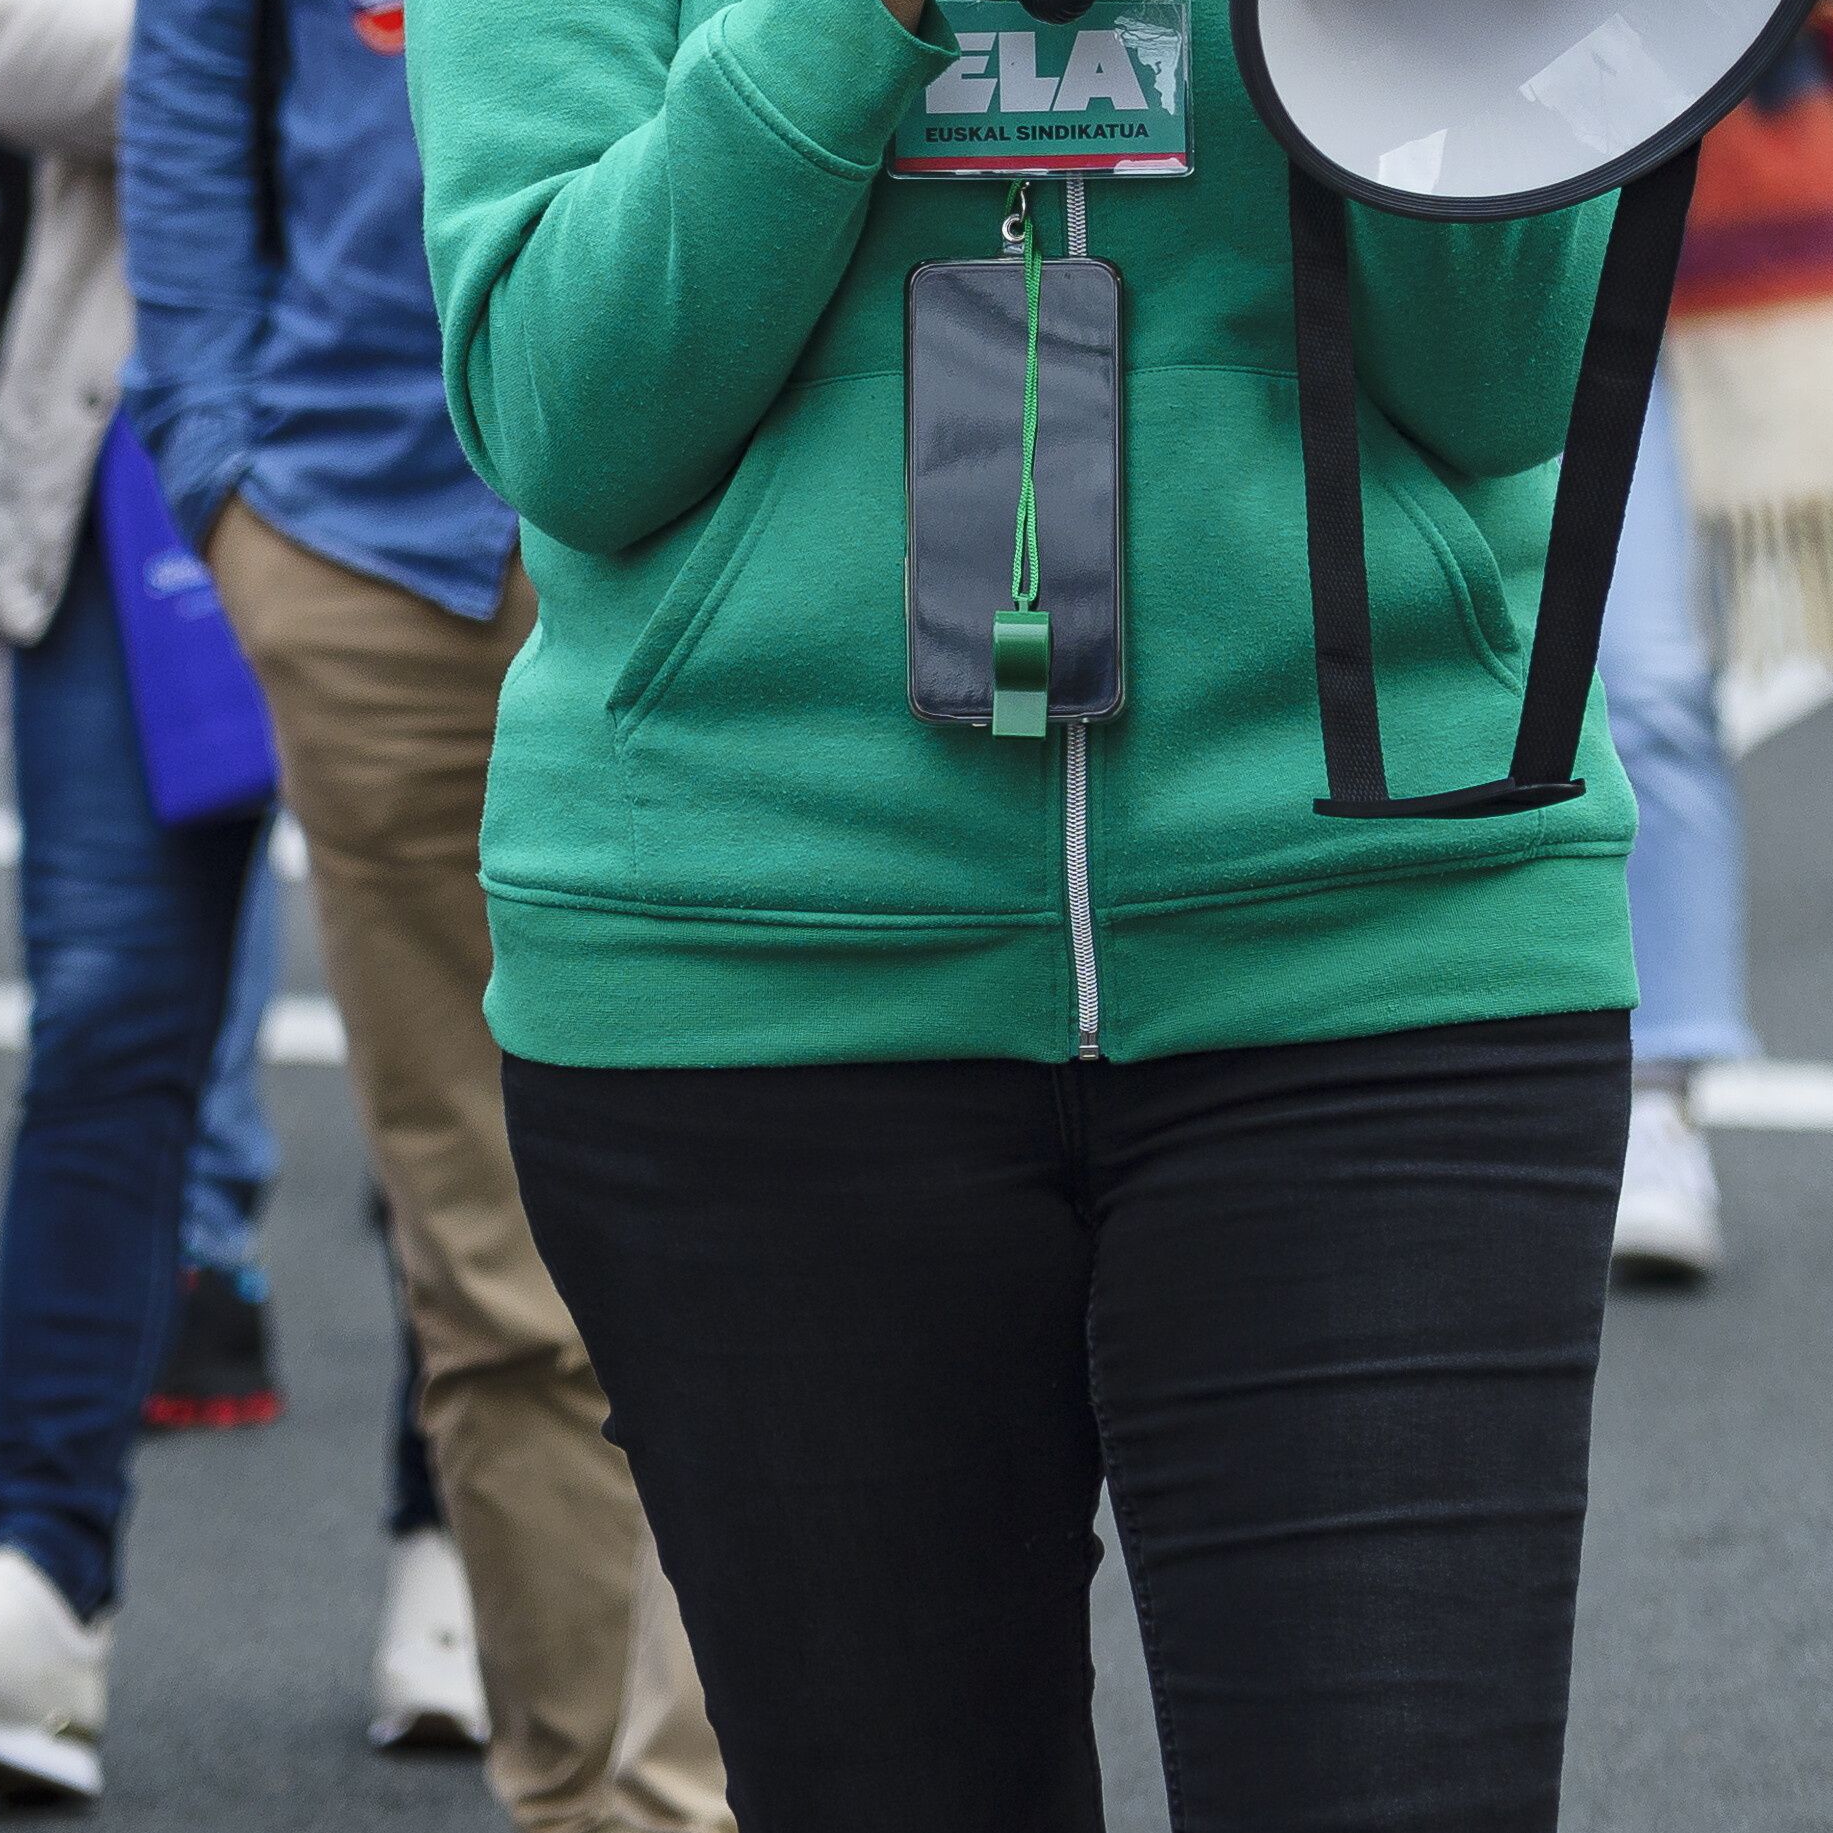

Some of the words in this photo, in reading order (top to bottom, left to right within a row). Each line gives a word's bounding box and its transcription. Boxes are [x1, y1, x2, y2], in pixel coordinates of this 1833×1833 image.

[925, 29, 1149, 114] ELA
[924, 125, 1011, 143] EUSKAL
[1016, 122, 1150, 142] SINDIKATUA
